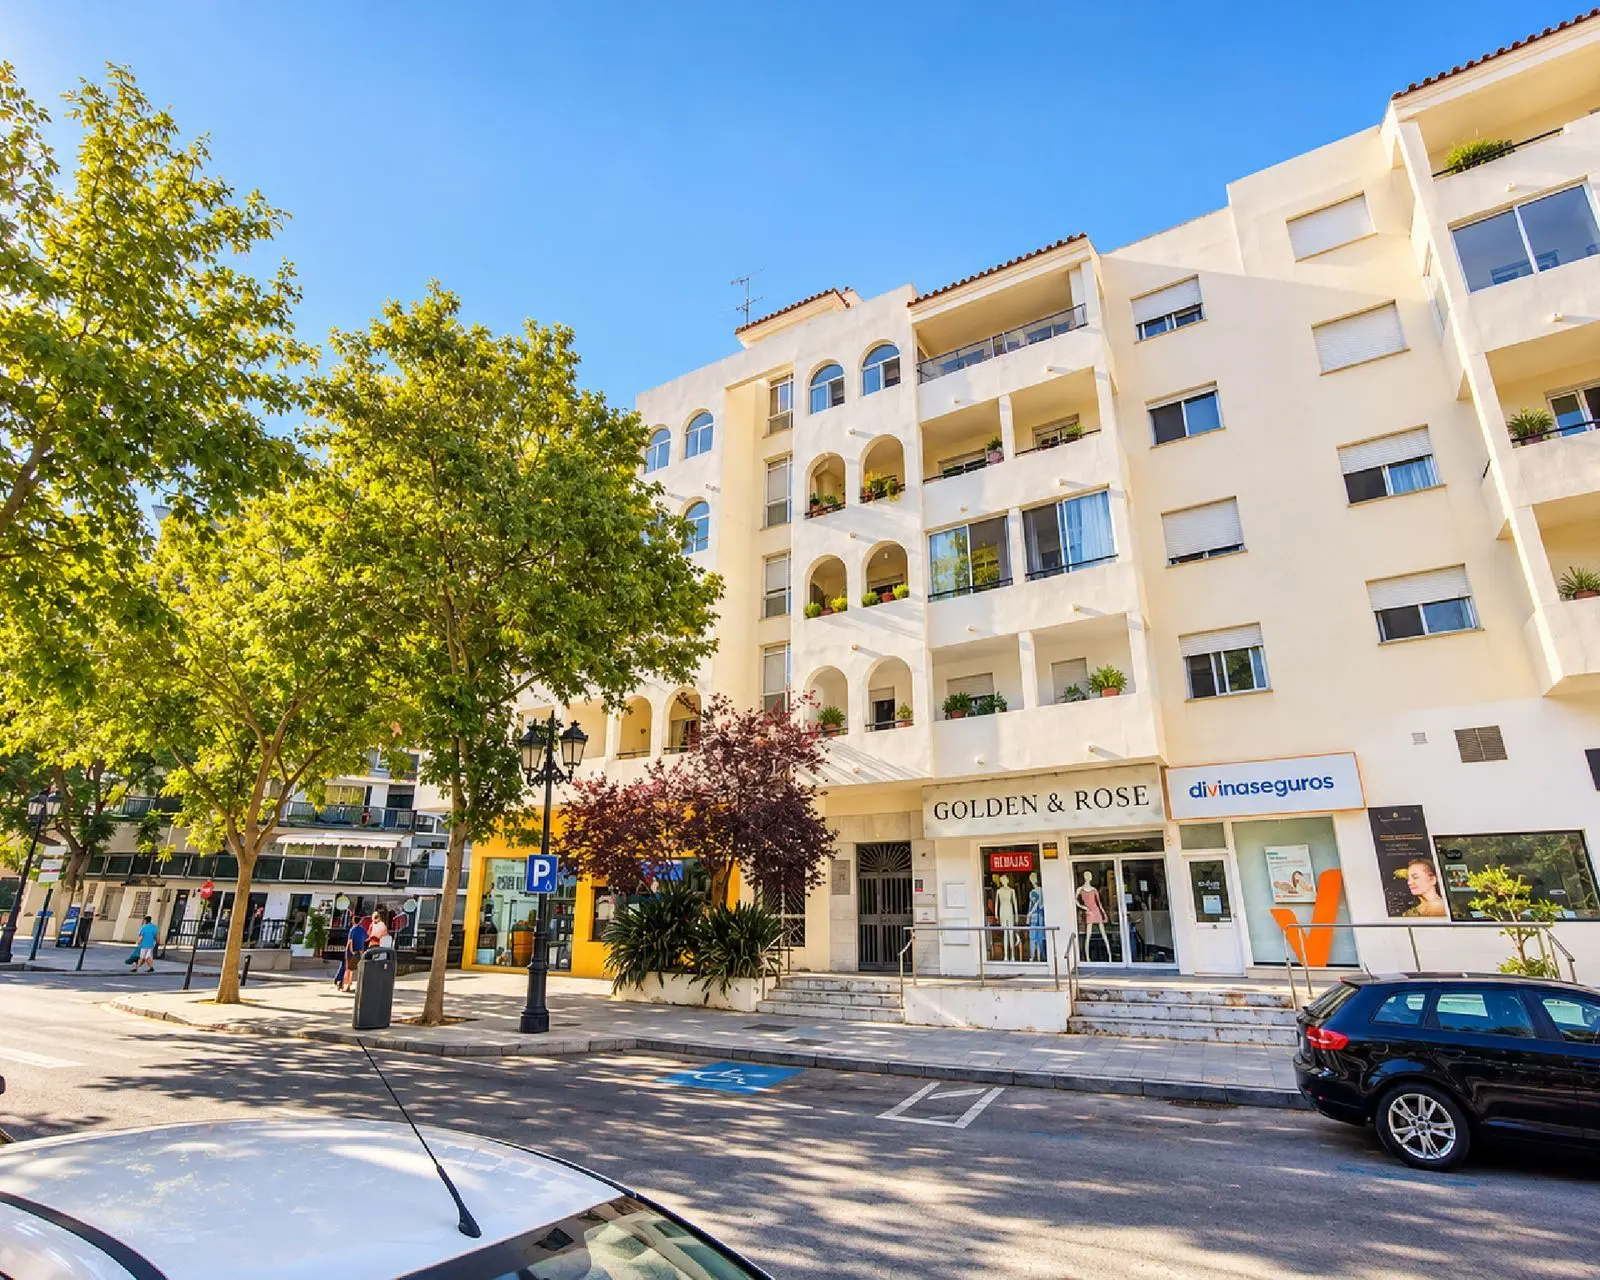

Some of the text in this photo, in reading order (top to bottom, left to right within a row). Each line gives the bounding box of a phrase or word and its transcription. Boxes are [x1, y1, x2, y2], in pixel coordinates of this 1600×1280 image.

[1189, 776, 1335, 798] divinaseguros
[934, 785, 1150, 820] GOLDEN & ROSE
[532, 859, 551, 887] P
